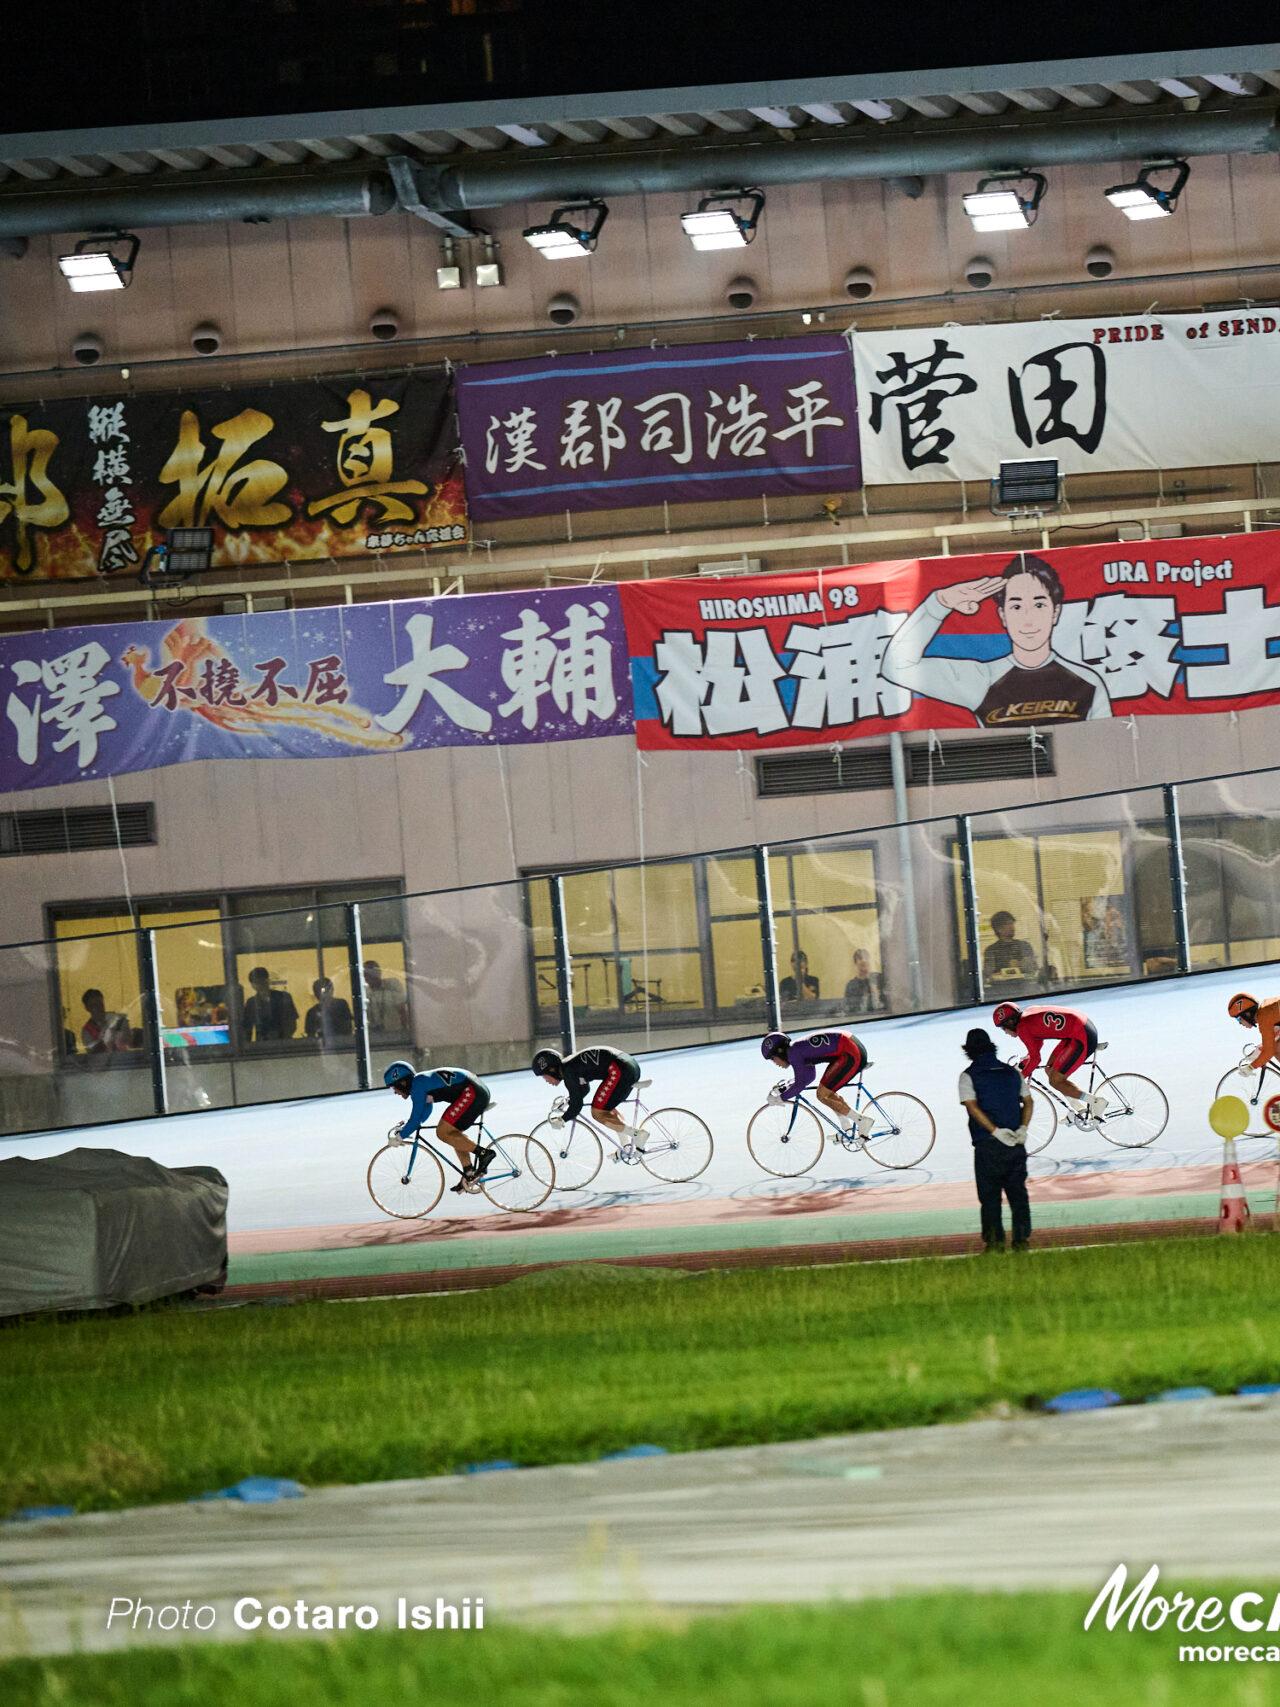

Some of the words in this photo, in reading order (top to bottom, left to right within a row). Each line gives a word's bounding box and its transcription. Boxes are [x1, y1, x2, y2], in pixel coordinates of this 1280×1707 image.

[1093, 323, 1164, 344] PRIDE
[1186, 322, 1209, 339] of
[868, 339, 1107, 471] 菅田
[157, 388, 429, 529] 拓真
[1103, 559, 1150, 584] URA
[1155, 558, 1233, 588] Project
[699, 591, 824, 620] HIROSHIMA
[828, 585, 859, 610] 98
[377, 600, 618, 735] 大輔
[653, 608, 913, 738] 松浦
[149, 654, 350, 713] 不撓不屈
[7, 641, 121, 768] 澤
[1005, 699, 1078, 717] KEIRIN
[1236, 1000, 1243, 1011] 7
[1043, 1010, 1066, 1031] 3
[808, 1034, 831, 1048] 9
[538, 1056, 548, 1070] 2
[581, 1049, 600, 1066] 2
[391, 1067, 399, 1079] 4
[436, 1070, 457, 1087] 4
